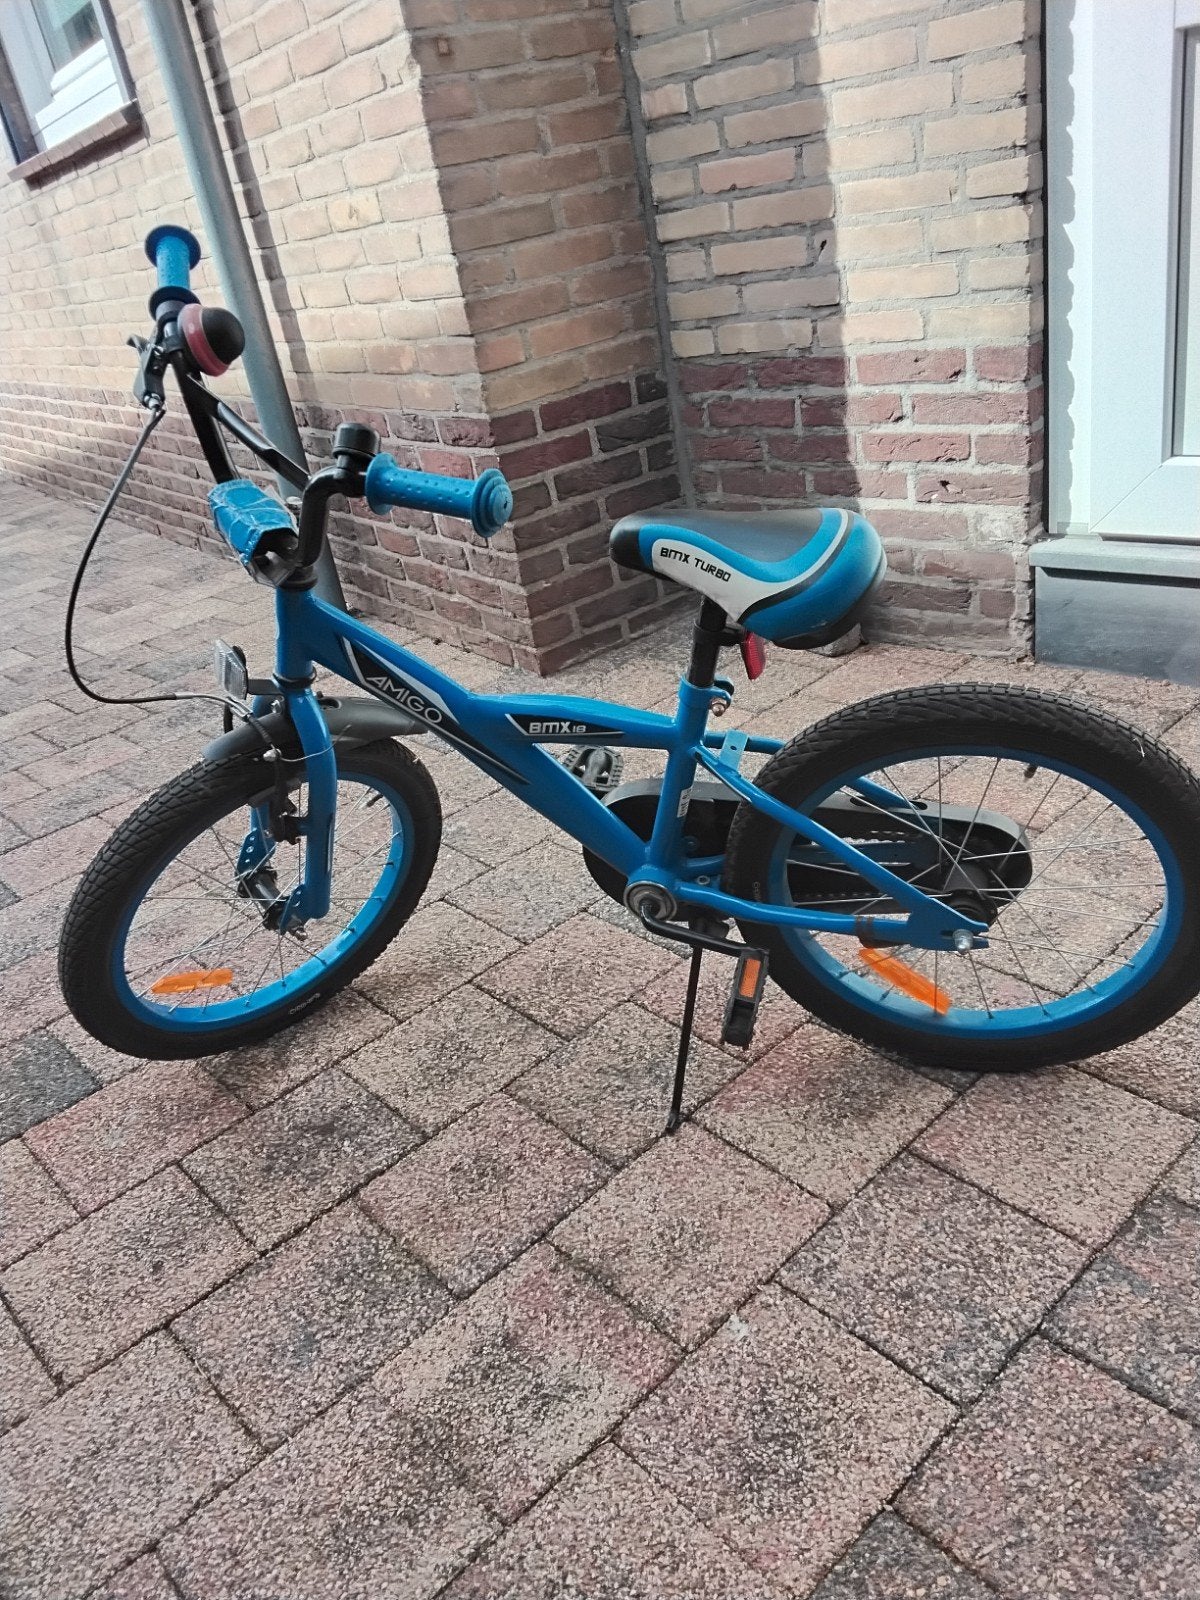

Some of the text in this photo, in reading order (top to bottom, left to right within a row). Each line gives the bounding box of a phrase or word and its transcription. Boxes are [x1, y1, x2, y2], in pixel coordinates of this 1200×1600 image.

[660, 547, 732, 582] BMX TURBO
[366, 676, 442, 723] AMIGO
[529, 721, 587, 734] BMX 18
